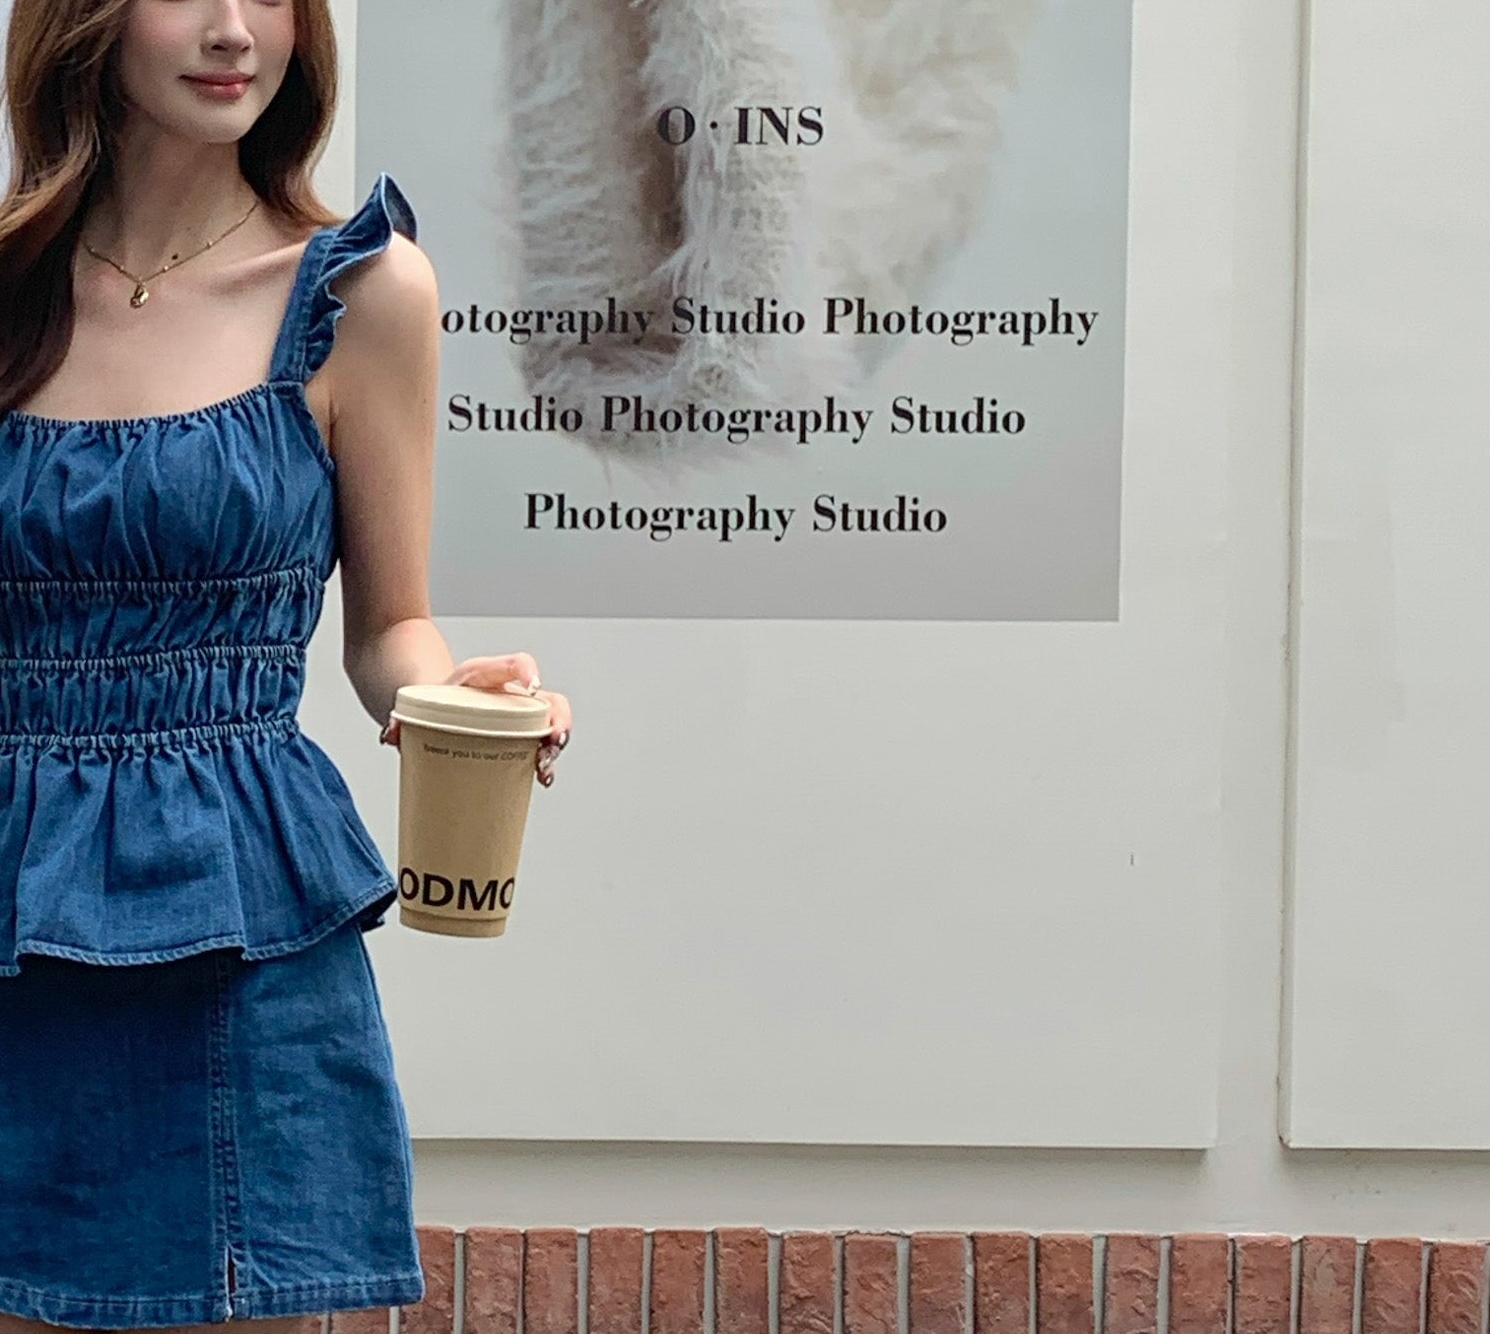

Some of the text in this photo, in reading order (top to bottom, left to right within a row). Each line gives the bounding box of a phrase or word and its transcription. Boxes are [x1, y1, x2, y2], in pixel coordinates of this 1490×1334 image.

[671, 296, 806, 335] Studio
[822, 296, 1100, 346] Photography
[447, 393, 1027, 444] Studio Photography Studio
[523, 492, 948, 543] Photography Studio
